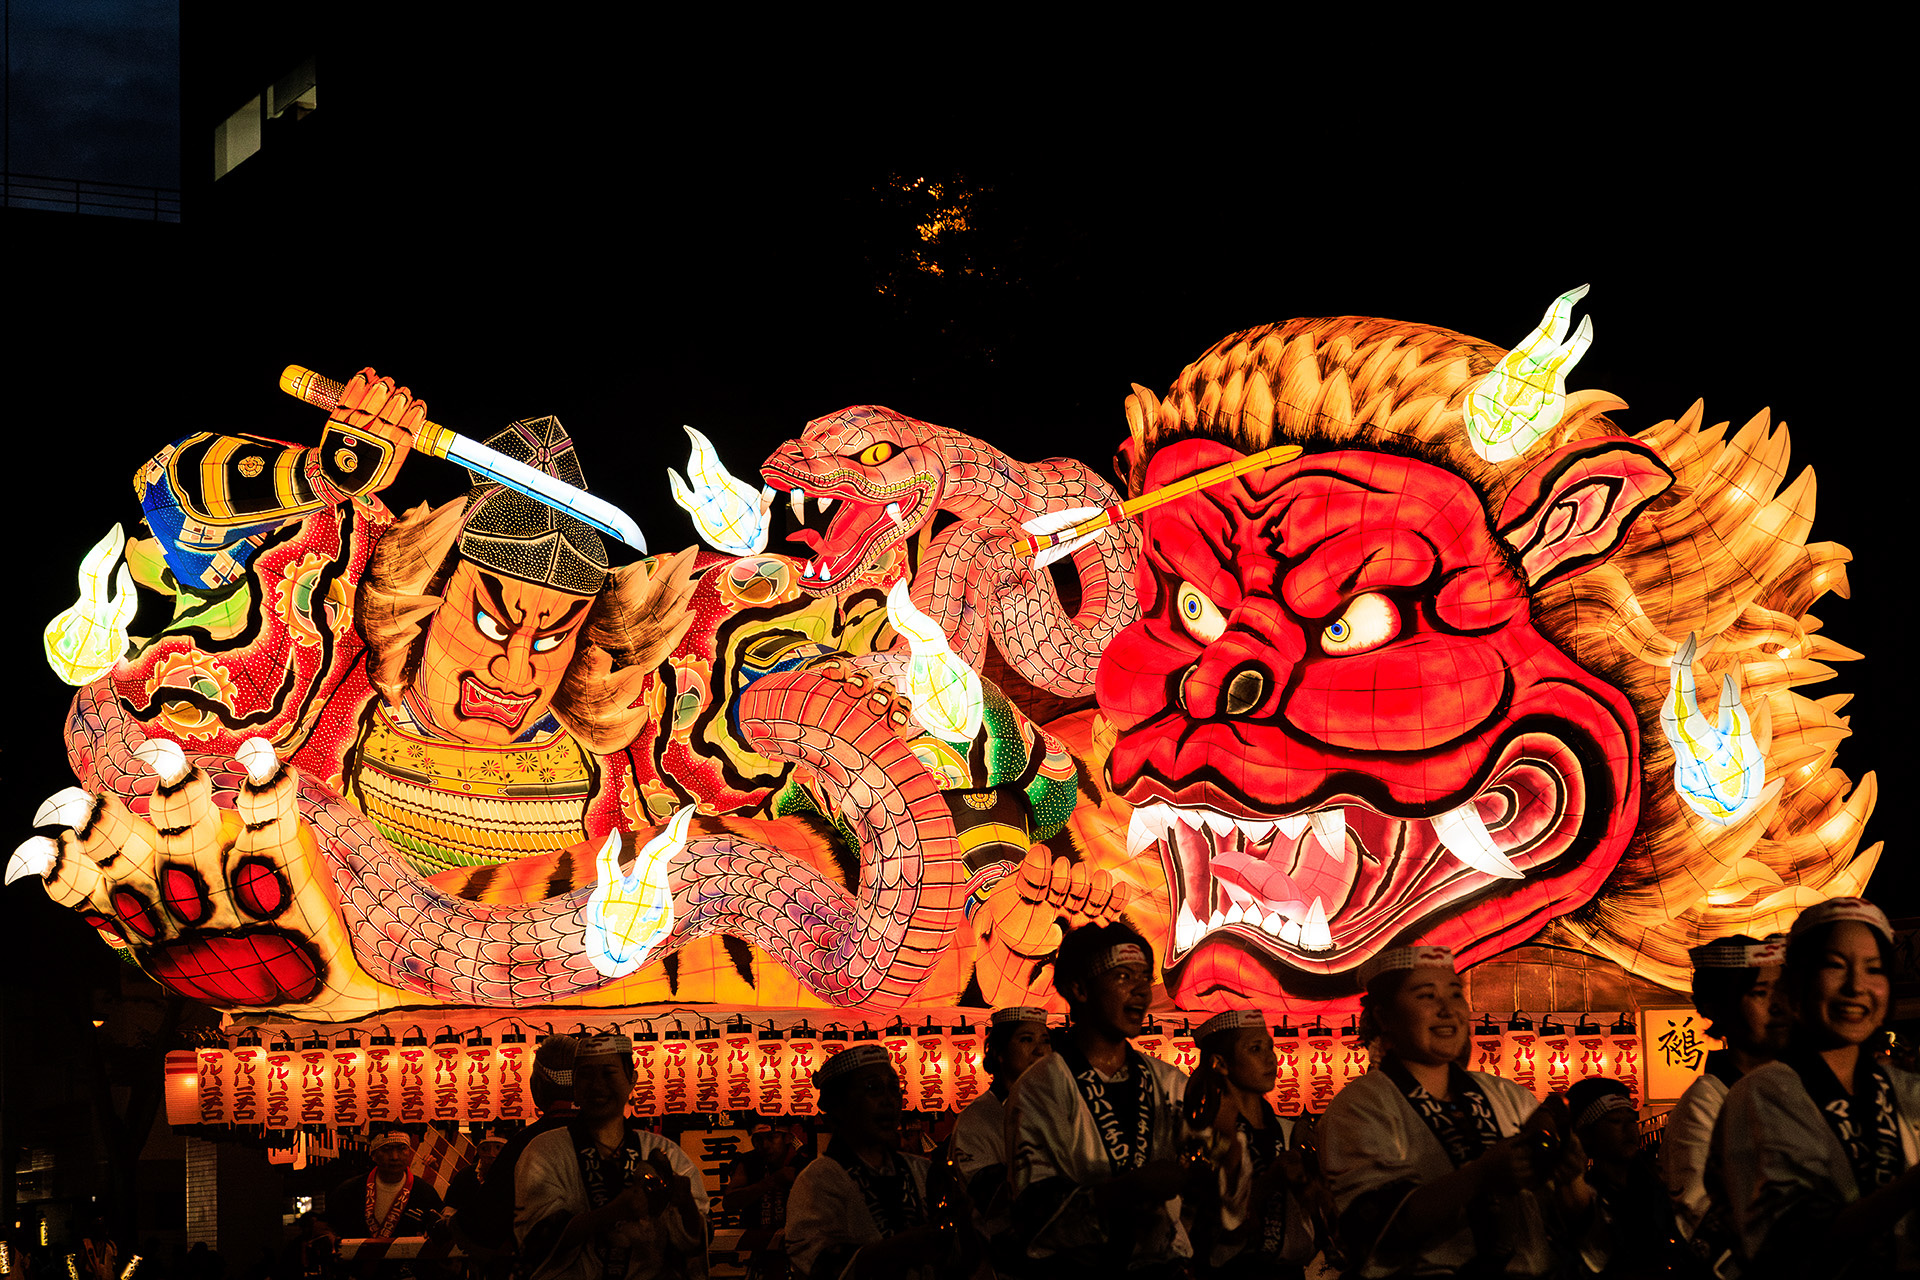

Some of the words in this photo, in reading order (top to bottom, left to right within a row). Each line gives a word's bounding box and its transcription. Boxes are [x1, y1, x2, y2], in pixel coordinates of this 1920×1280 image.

[200, 1052, 224, 1121] マルハニチロ
[233, 1050, 257, 1121] マルハニチロ
[267, 1055, 290, 1126] マルハニチロ
[301, 1052, 325, 1121] マルハニチロ
[333, 1052, 357, 1123] マルハニチロ
[366, 1049, 390, 1118] マルハニチロ
[400, 1050, 424, 1120] マルハニチロ
[433, 1048, 458, 1118] マルハニチロ
[466, 1049, 490, 1119] マルハニチロ
[500, 1047, 522, 1117] マルハニチロ
[632, 1045, 656, 1114] マルハニチロ
[663, 1043, 687, 1112] マルハニチロ
[696, 1042, 719, 1113] マルハニチロ
[727, 1037, 751, 1108] マルハニチロ
[758, 1043, 782, 1114] マルハニチロ
[790, 1042, 814, 1113] マルハニチロ
[918, 1038, 943, 1109] マルハニチロ
[1274, 1042, 1300, 1113] マルハニチロ
